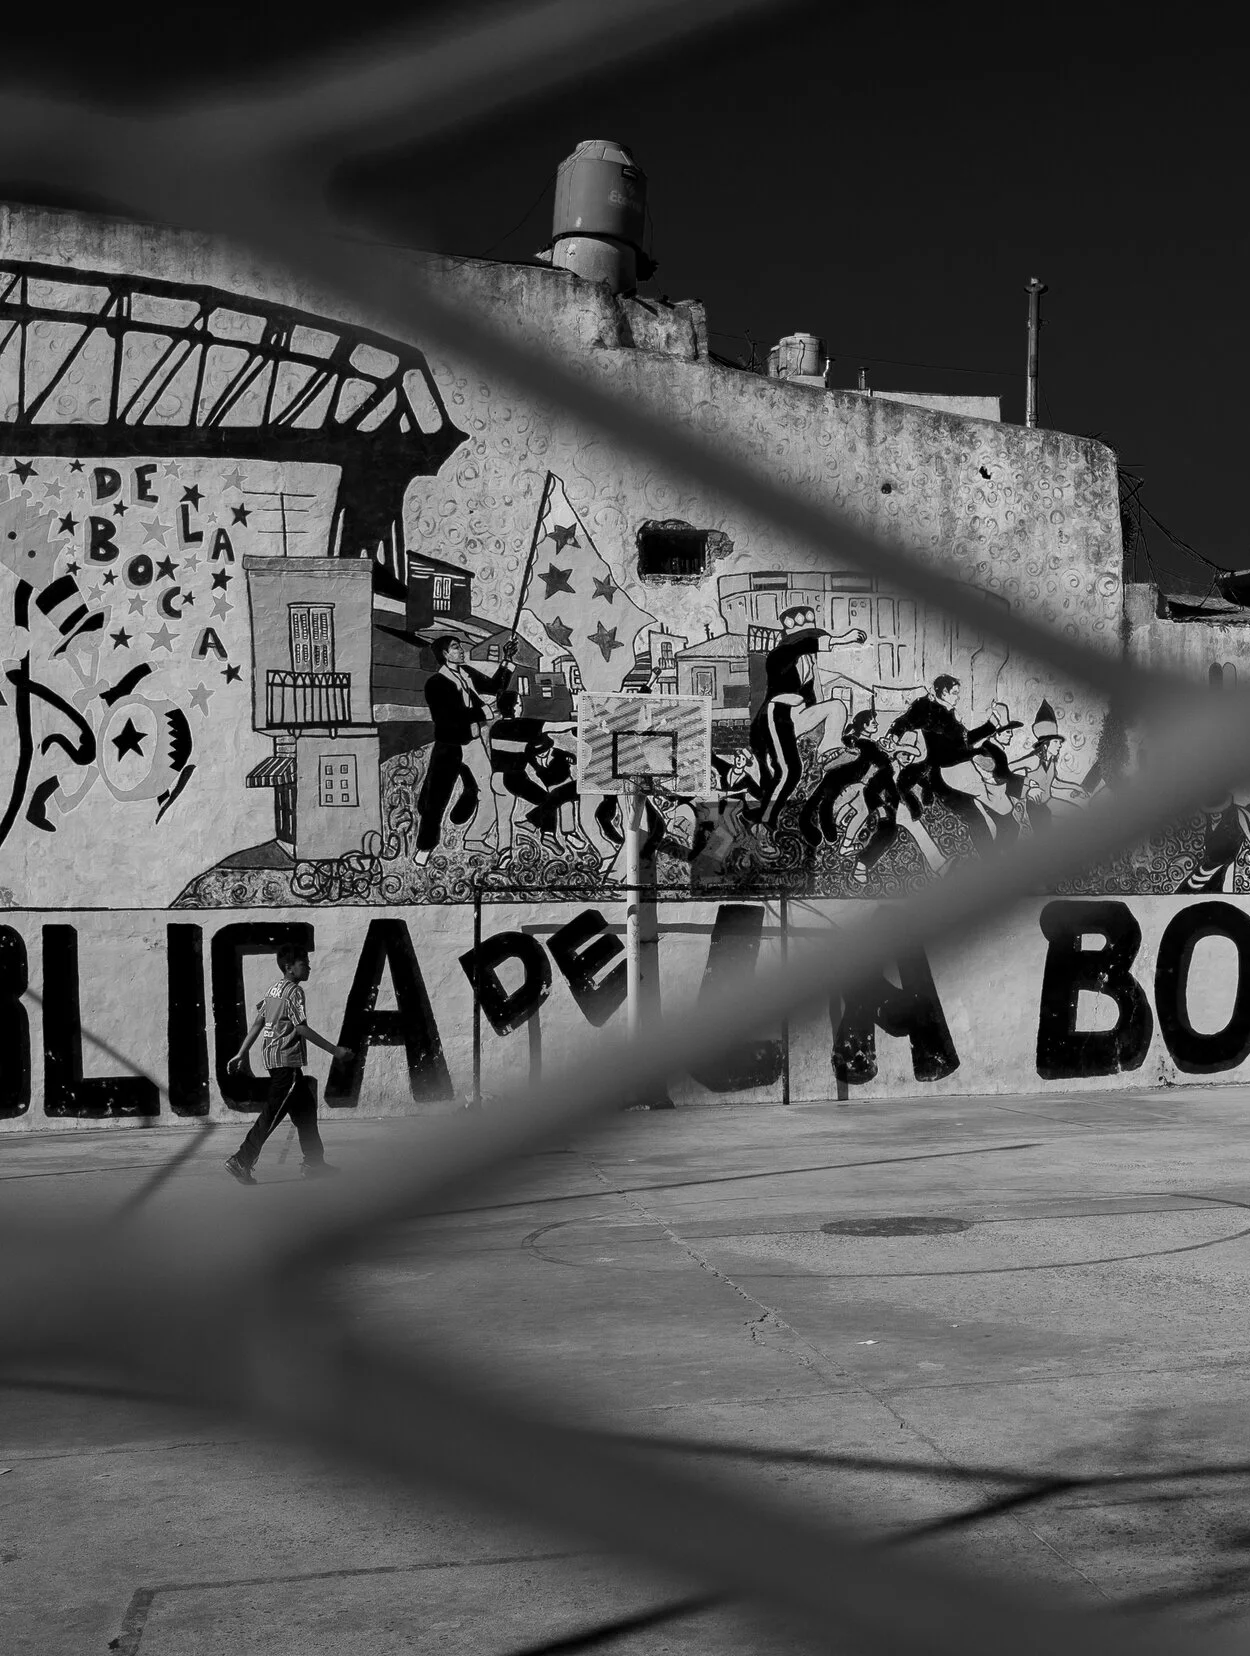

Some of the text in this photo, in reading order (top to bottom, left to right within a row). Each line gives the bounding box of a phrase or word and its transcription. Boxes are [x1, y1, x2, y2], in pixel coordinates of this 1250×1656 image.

[91, 464, 235, 564] DE LA
[84, 514, 228, 661] BOCA
[458, 908, 628, 1037] DE
